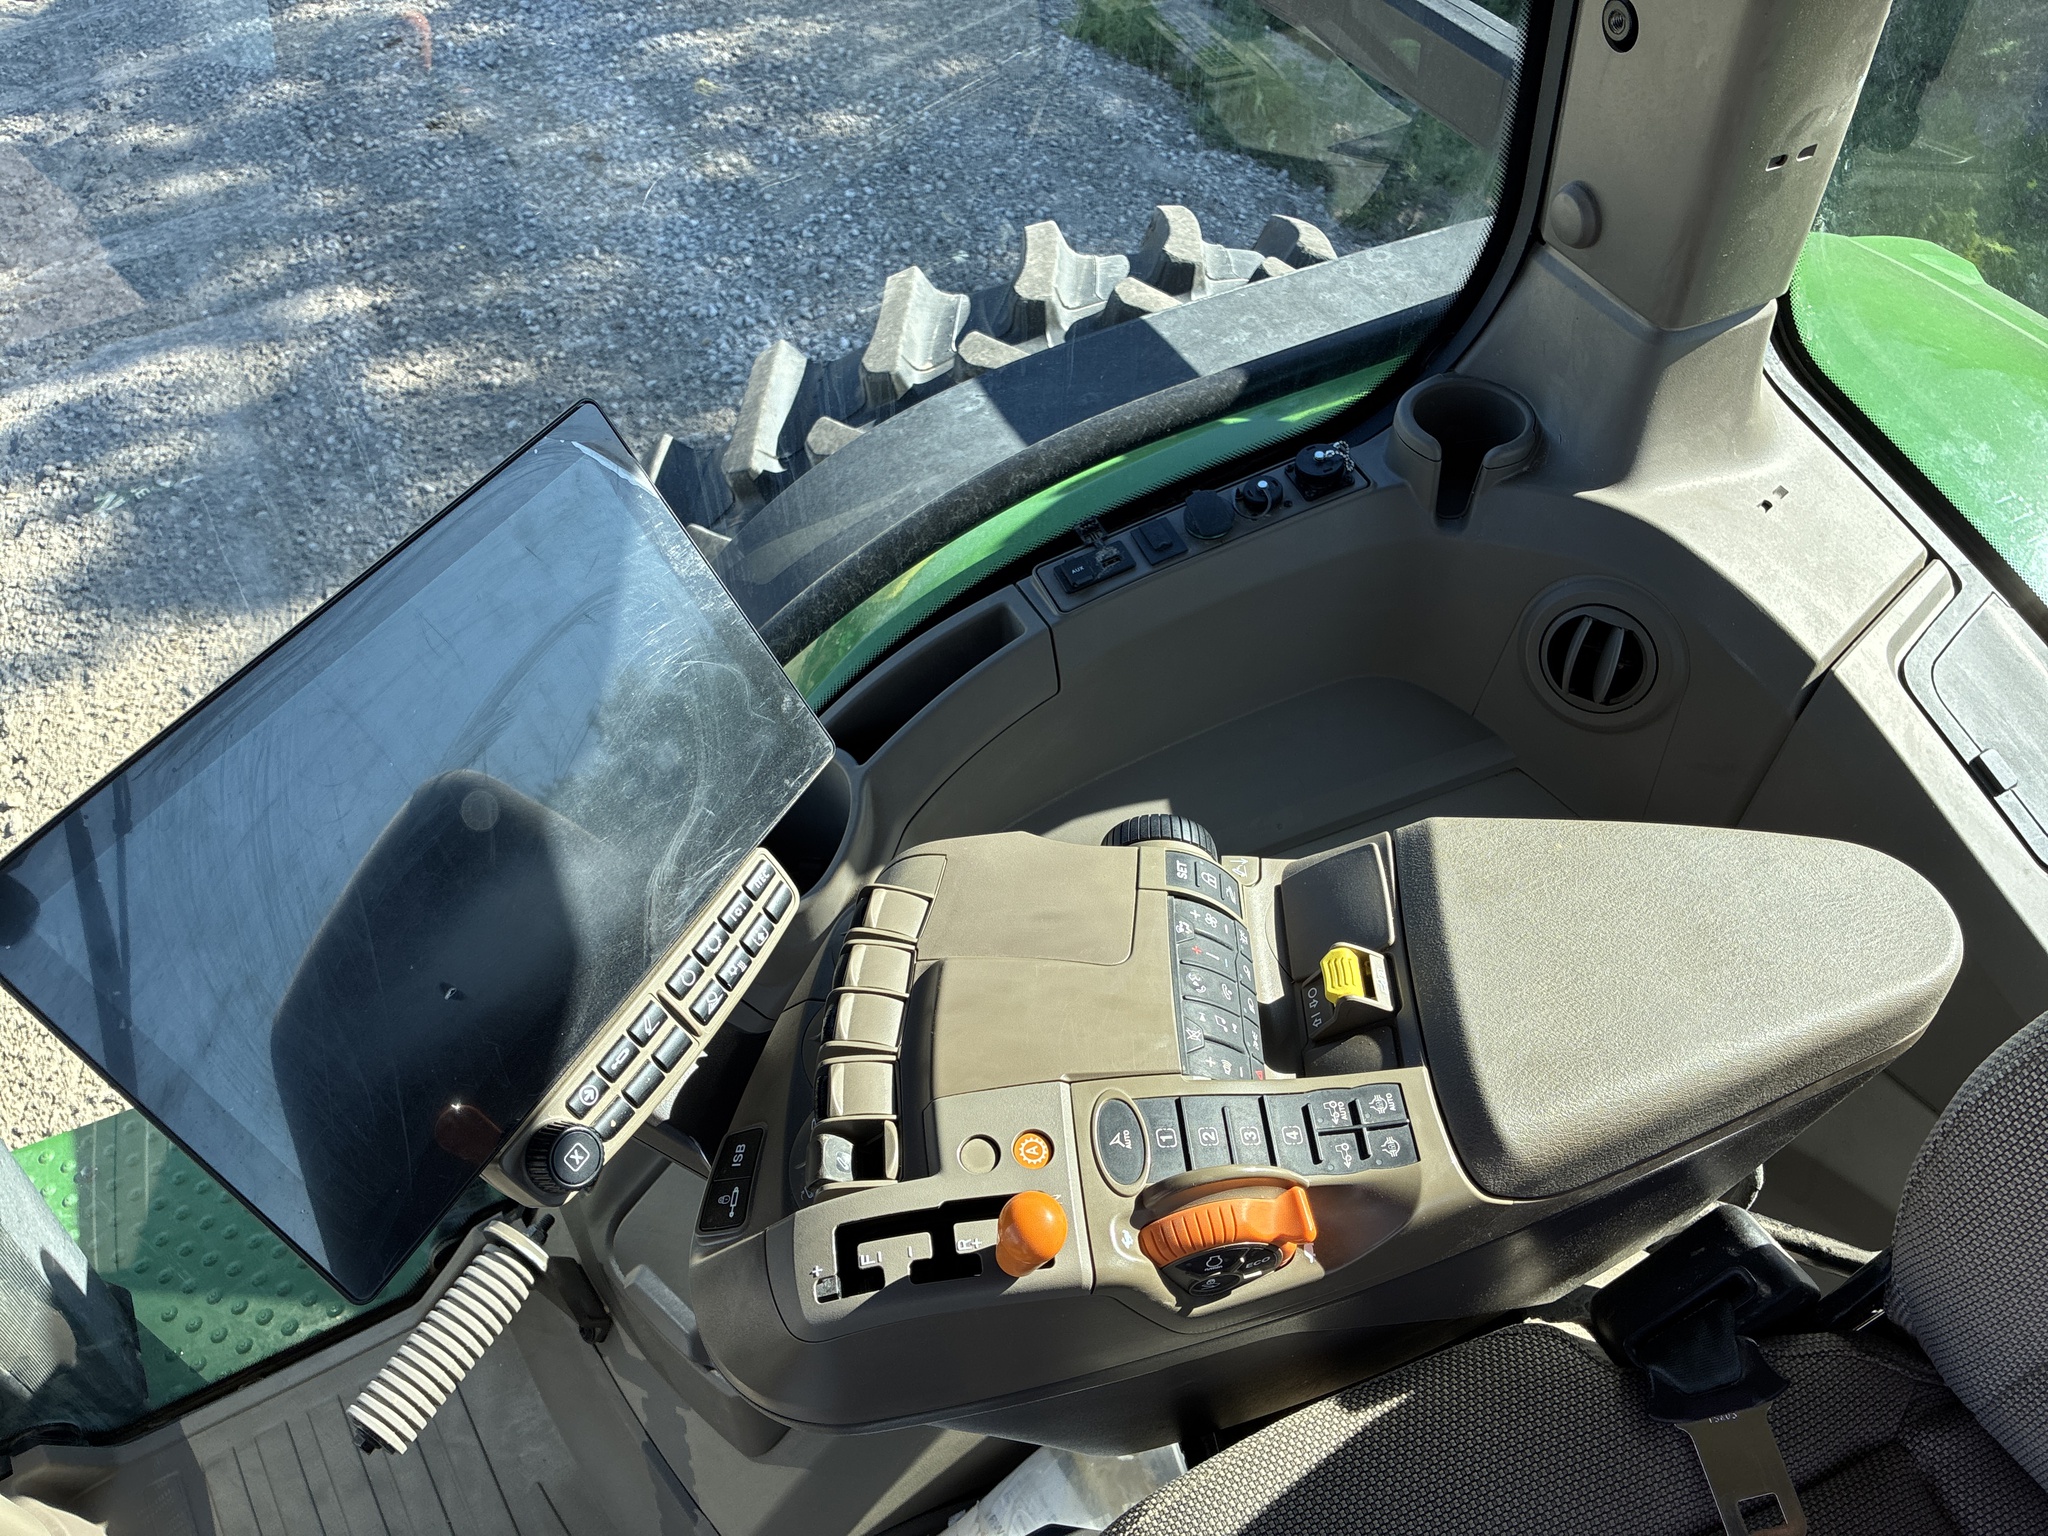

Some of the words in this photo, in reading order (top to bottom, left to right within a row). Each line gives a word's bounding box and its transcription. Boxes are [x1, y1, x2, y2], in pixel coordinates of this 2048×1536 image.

[1071, 565, 1085, 574] AUX
[1176, 859, 1188, 880] SET
[1385, 1092, 1397, 1111] AUTO
[1337, 1101, 1348, 1120] AUTO
[1122, 1129, 1132, 1149] AUTO
[1159, 1134, 1173, 1143] 1
[1202, 1131, 1216, 1141] 2
[1244, 1131, 1257, 1141] 3
[1286, 1130, 1299, 1140] 4
[731, 1143, 746, 1167] ISB
[1025, 1145, 1039, 1156] A
[957, 1238, 973, 1251] R
[860, 1253, 876, 1266] F
[1245, 1256, 1271, 1269] ECO
